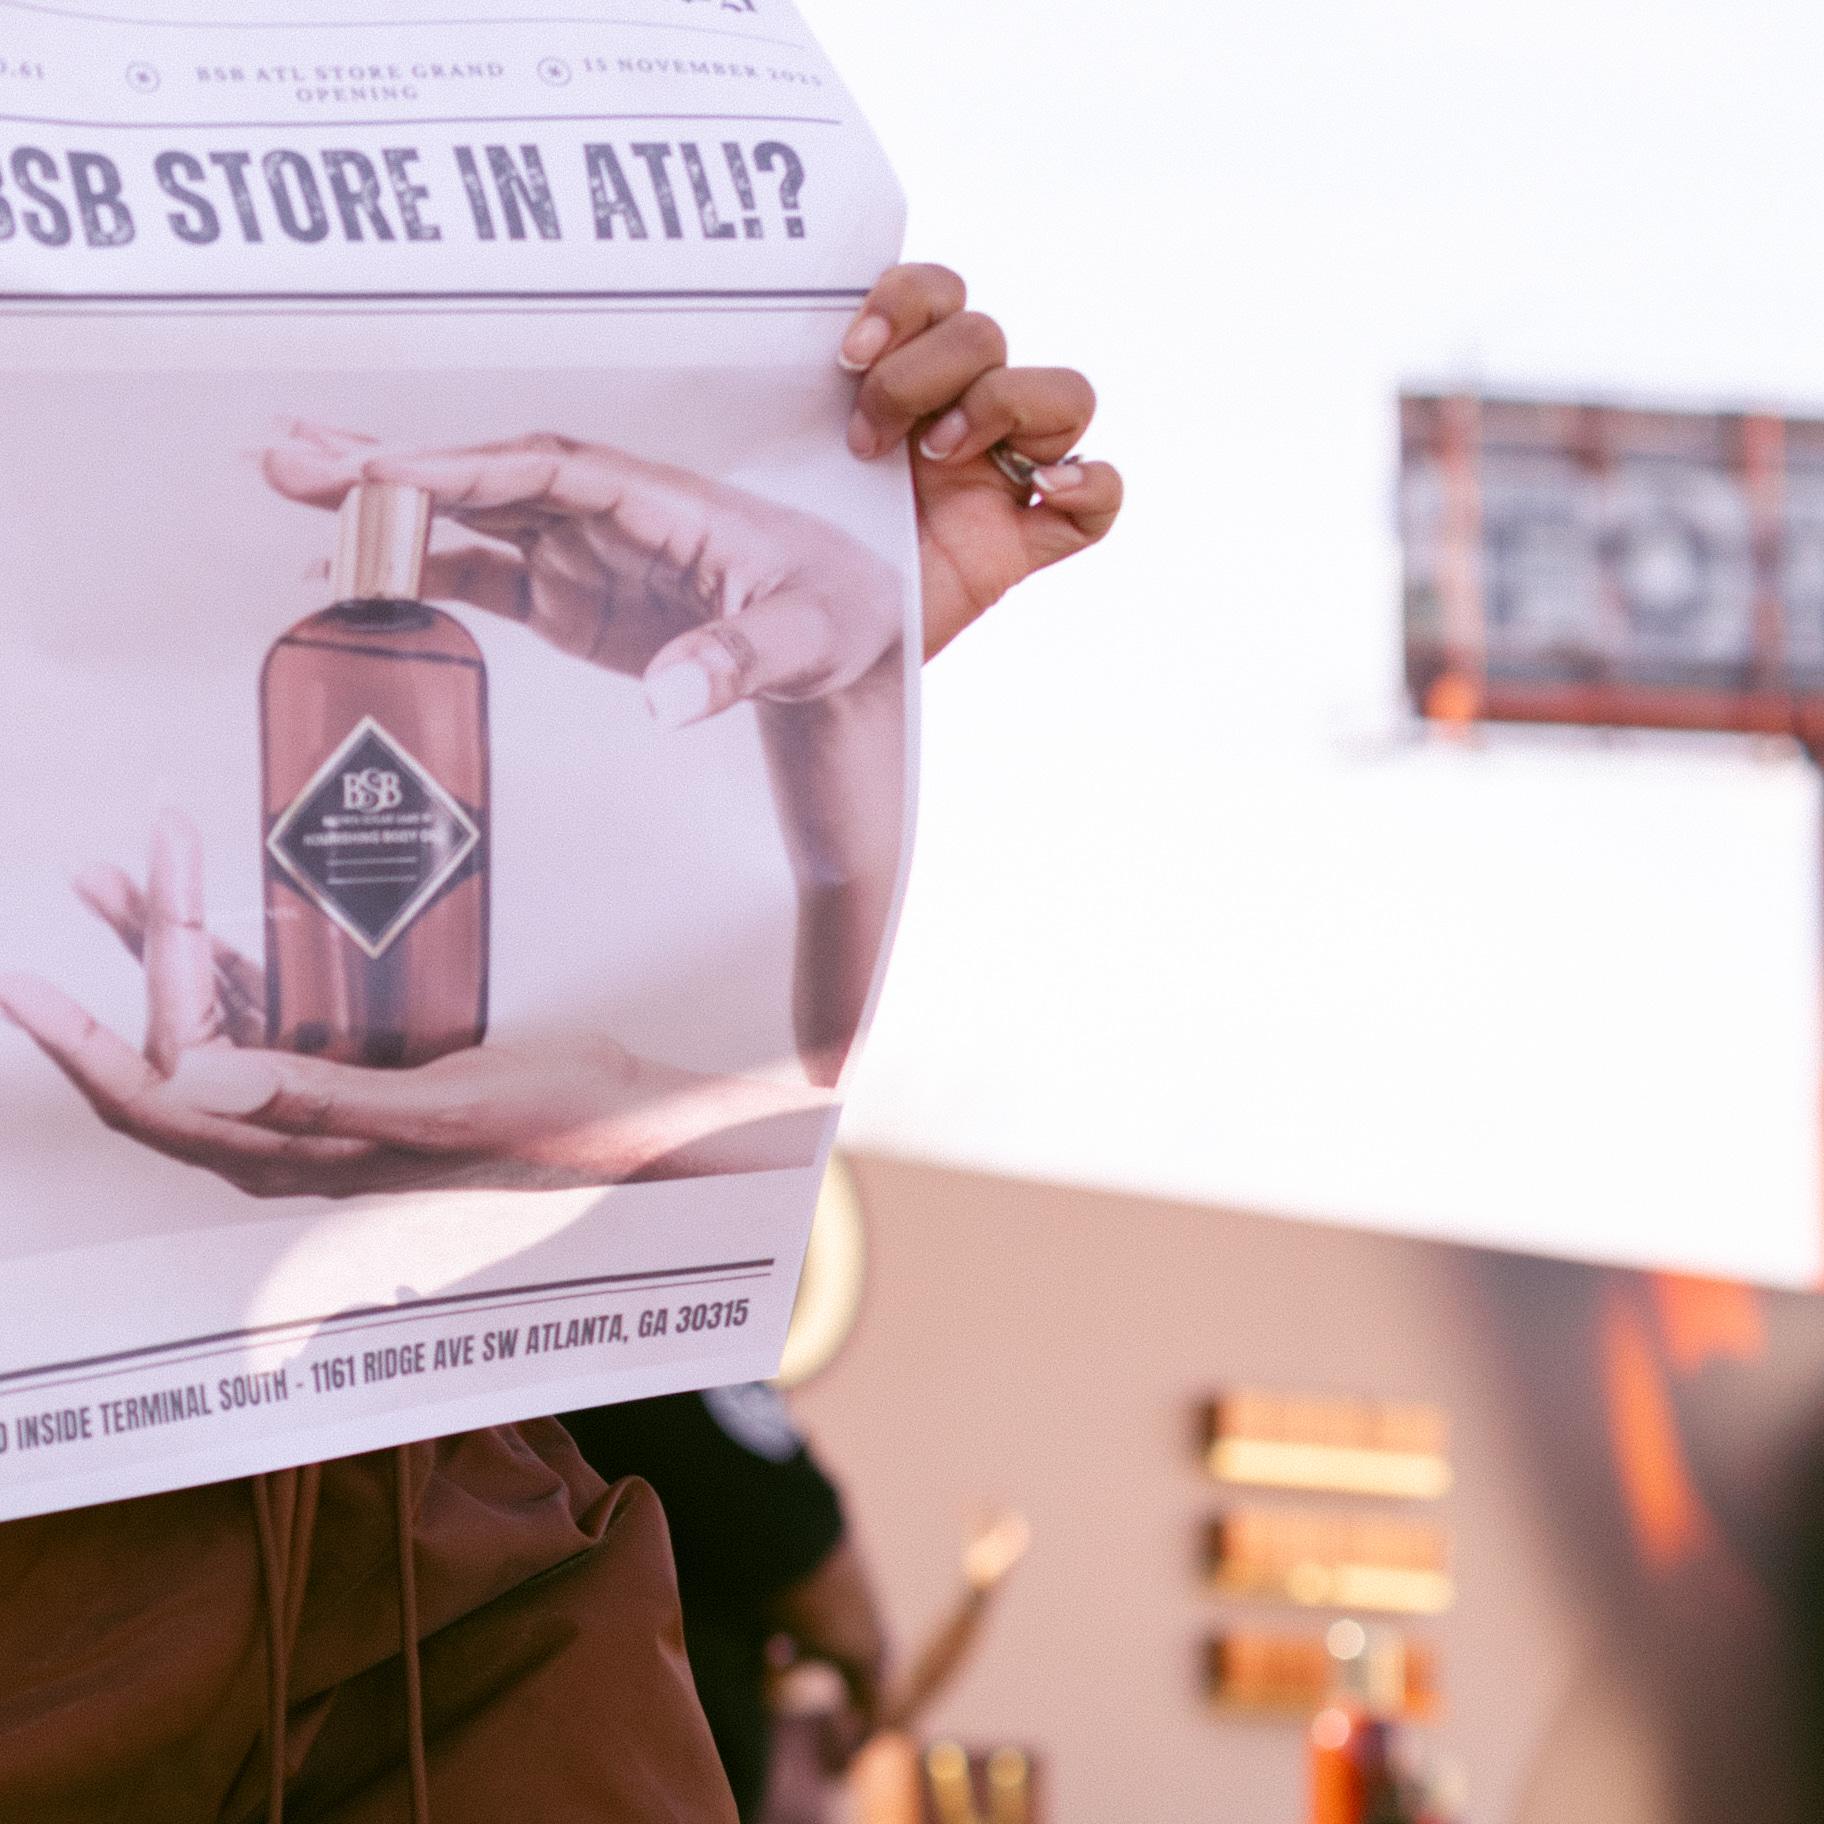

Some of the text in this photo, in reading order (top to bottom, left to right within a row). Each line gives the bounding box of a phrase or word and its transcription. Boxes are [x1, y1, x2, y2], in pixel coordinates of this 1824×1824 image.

[255, 65, 304, 82] ATL
[314, 65, 401, 81] STORE
[411, 62, 506, 79] GRAND
[616, 57, 759, 80] NOVEMBER
[295, 85, 420, 104] OPENING
[151, 147, 443, 246] STORE
[451, 143, 563, 242] IN
[582, 141, 807, 242] ATL!?
[343, 767, 404, 813] BSB
[15, 1407, 92, 1451] INSIDE
[99, 1385, 212, 1436] TERMINAL
[219, 1368, 288, 1410] SOUTH
[311, 1356, 356, 1393] 1161
[362, 1342, 426, 1383] RIDGE
[433, 1334, 475, 1371] AVE
[482, 1328, 520, 1363] SW
[526, 1313, 628, 1355] ATLANTA,
[638, 1307, 669, 1339] GA
[676, 1298, 750, 1334] 30315
